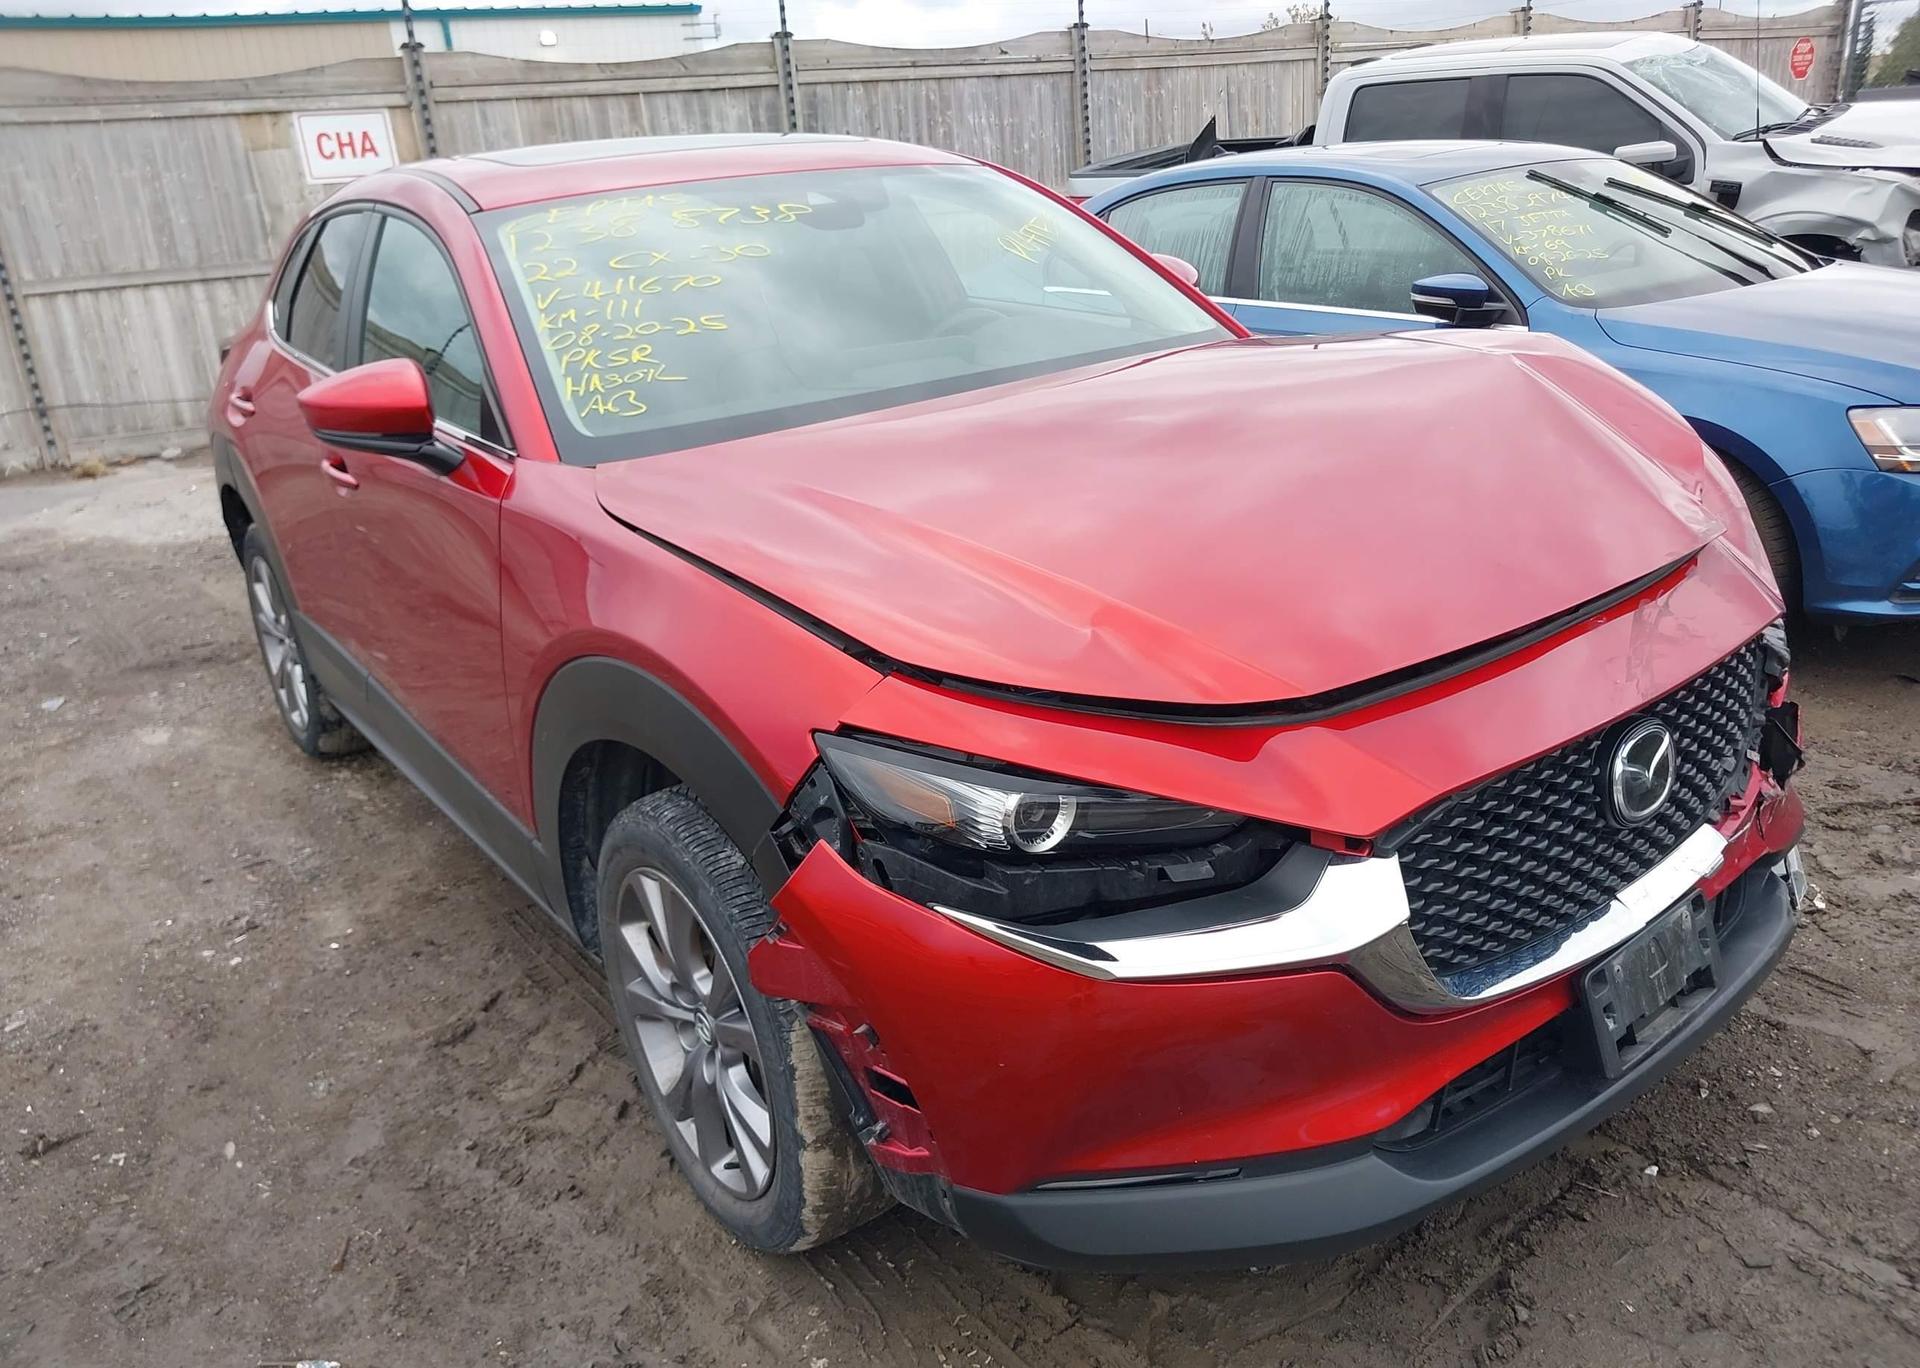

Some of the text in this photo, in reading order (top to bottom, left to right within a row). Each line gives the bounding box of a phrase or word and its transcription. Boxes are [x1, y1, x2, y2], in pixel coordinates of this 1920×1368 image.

[316, 131, 379, 160] CHA
[523, 257, 578, 283] 22
[547, 314, 728, 350] 08-20-25
